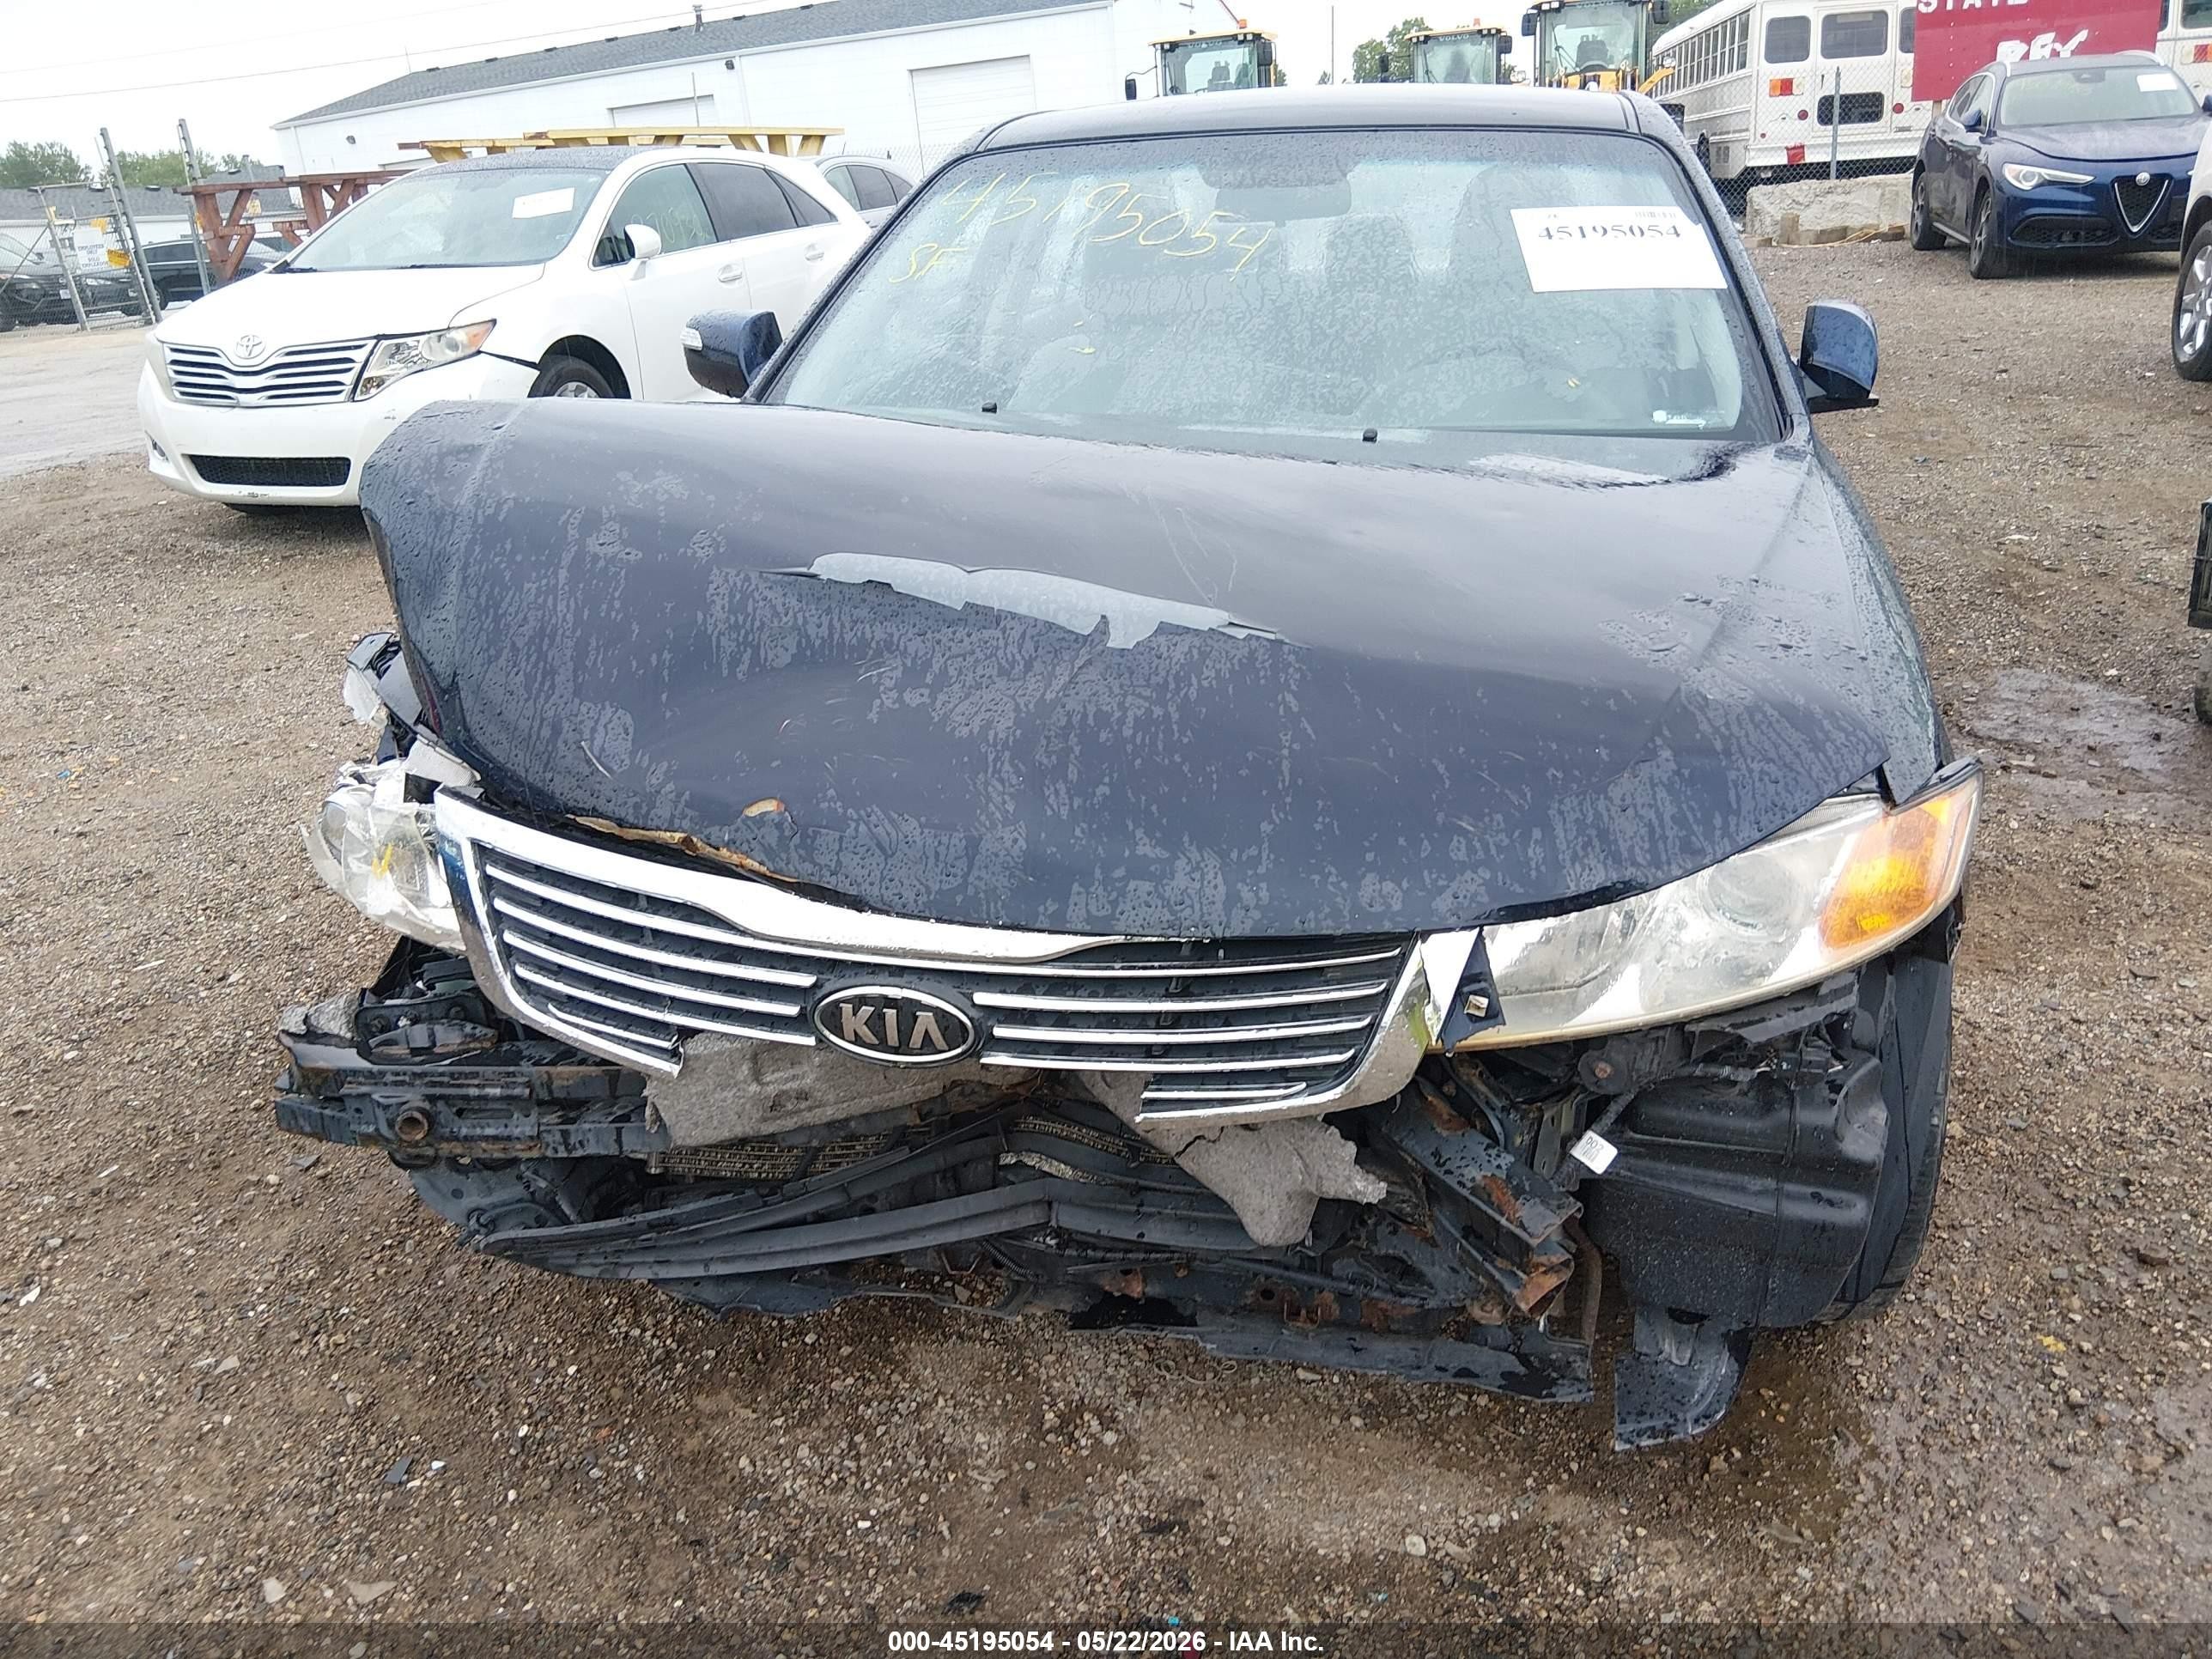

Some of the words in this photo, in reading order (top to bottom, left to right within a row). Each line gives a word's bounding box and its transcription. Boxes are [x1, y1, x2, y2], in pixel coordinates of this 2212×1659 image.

[1439, 33, 1470, 42] VOLVO
[940, 173, 1272, 282] 45195054
[1538, 223, 1681, 240] 45195054
[839, 1002, 949, 1051] KIA
